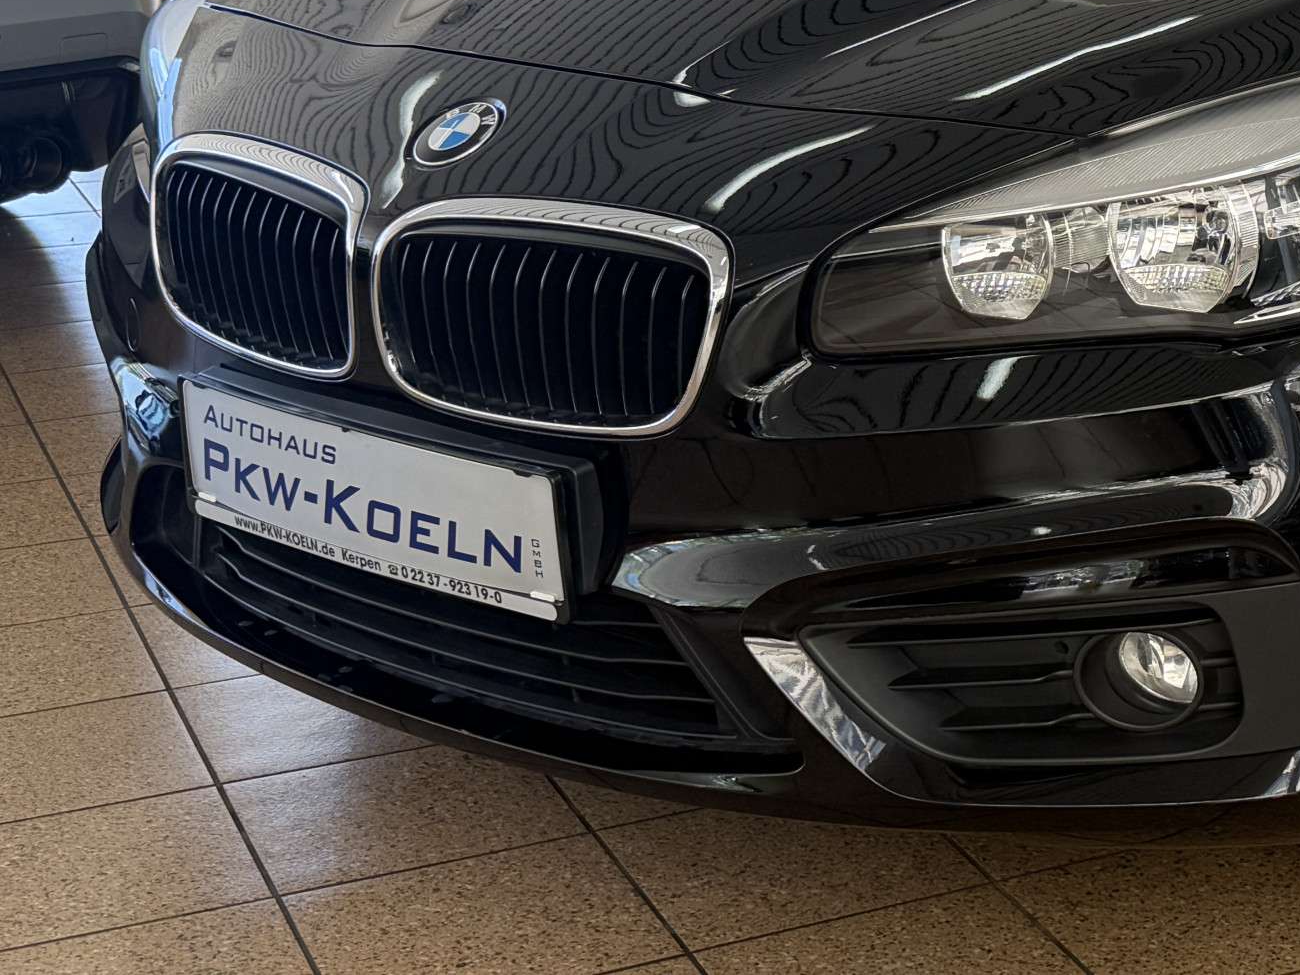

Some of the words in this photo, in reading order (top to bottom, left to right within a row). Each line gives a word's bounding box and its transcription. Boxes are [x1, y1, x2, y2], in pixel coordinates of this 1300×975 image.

[203, 404, 337, 465] AUTOHAUS
[234, 515, 336, 558] www.PKW-KOELN.de
[340, 547, 382, 572] Kerpen
[531, 538, 544, 578] GMBH
